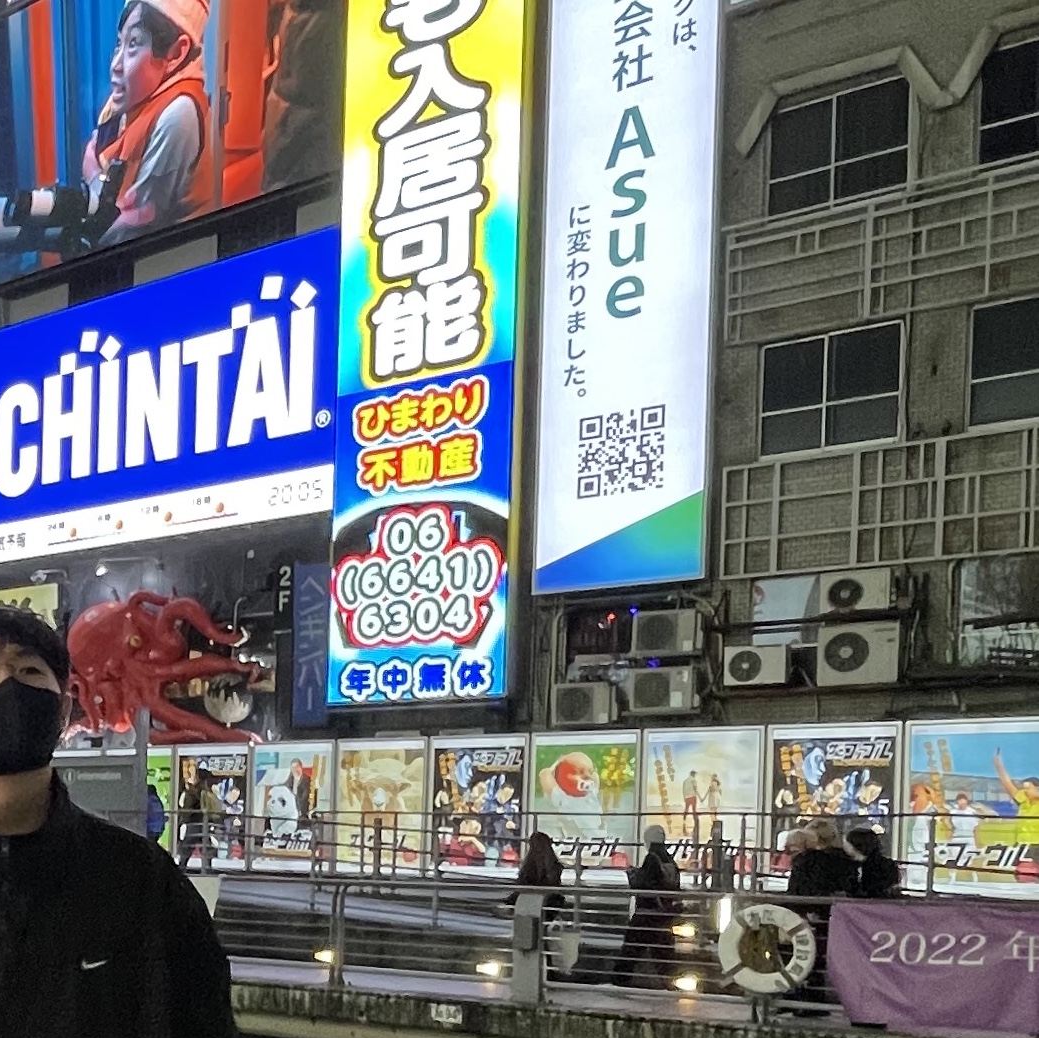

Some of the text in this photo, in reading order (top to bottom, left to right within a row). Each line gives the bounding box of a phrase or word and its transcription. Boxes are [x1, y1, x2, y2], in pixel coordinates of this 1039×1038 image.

[604, 105, 656, 320] Asue
[563, 205, 591, 398] に変わりました。
[356, 379, 488, 442] ひまわり
[358, 435, 480, 492] 不動産
[386, 513, 444, 556] 06
[341, 549, 493, 605] (6641)
[360, 596, 473, 639] 6304
[343, 657, 489, 699] 年中無休
[869, 930, 987, 965] 2022
